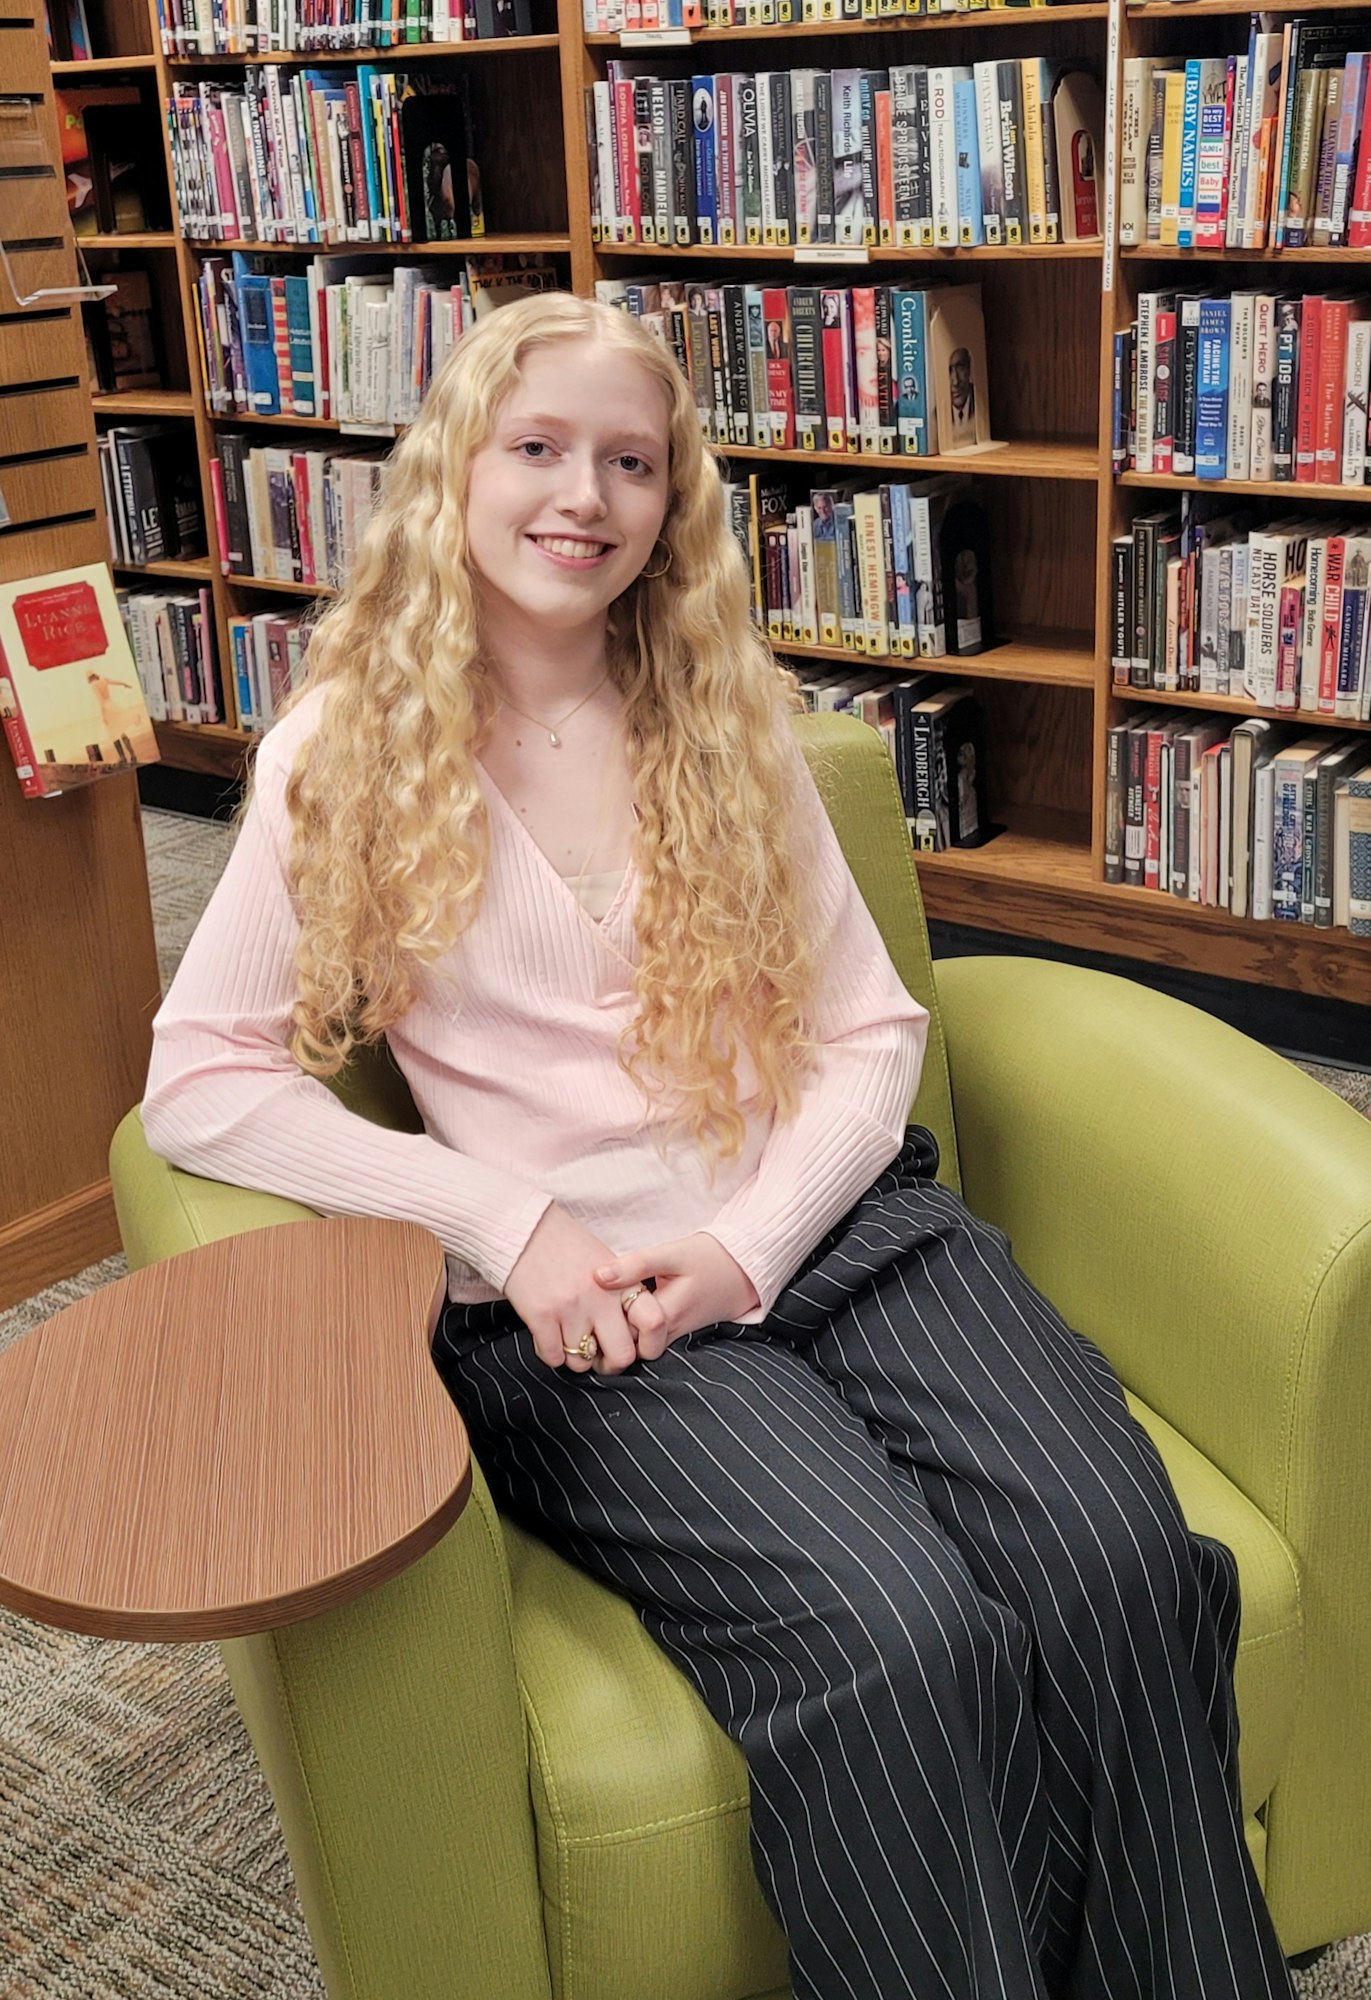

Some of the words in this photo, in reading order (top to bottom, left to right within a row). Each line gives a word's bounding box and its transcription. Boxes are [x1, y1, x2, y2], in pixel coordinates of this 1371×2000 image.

[982, 68, 991, 113] SHANIA
[1239, 66, 1247, 80] The
[248, 93, 257, 117] AWE
[270, 80, 279, 115] Detroit
[619, 86, 627, 125] SOPHIA
[676, 90, 685, 118] HARD
[843, 86, 852, 109] Keith
[894, 77, 907, 116] BRUCE
[934, 88, 945, 119] ROD
[1026, 82, 1034, 100] Am
[1186, 80, 1197, 128] BABY
[1235, 83, 1244, 124] American
[1328, 77, 1337, 105] SAVILL
[652, 87, 664, 134] NELSON
[720, 105, 728, 136] MEACHAM
[743, 88, 756, 137] OLIVIA
[961, 98, 969, 140] DINNERS
[1000, 100, 1012, 146] Brian
[1027, 104, 1037, 141] Malala
[1203, 114, 1222, 122] BEST
[252, 121, 266, 176] INSPIRING
[621, 128, 629, 162] LOREN
[677, 121, 686, 144] CALL
[844, 112, 853, 153] Richards
[861, 126, 872, 161] WILLIAM
[920, 99, 930, 174] ELVIS
[985, 114, 995, 153] TWAIN
[1300, 120, 1311, 170] PATTERSON
[1325, 119, 1337, 169] ALEXANDER
[342, 141, 350, 183] SEABISCUIT
[641, 157, 649, 183] ROB
[843, 161, 853, 178] Life
[896, 121, 910, 200] SPRINGSTEEN
[1003, 145, 1016, 200] Wilson
[1107, 152, 1114, 177] ON
[1181, 130, 1195, 186] NAMES
[1201, 159, 1220, 170] best
[1232, 147, 1240, 174] Thomas
[762, 164, 770, 202] MICHELLE
[820, 148, 828, 207] REYNOLDS
[862, 163, 873, 198] SHATNER
[1148, 167, 1160, 214] WOMEN
[1200, 177, 1219, 187] Baby
[1324, 172, 1332, 186] THE
[1321, 188, 1332, 214] GREAT
[1104, 194, 1114, 290] SHELVES
[792, 307, 816, 315] ROBERTS
[793, 297, 814, 306] ANDREW
[1140, 299, 1150, 337] STEPHEN
[692, 321, 703, 355] LAURA
[710, 314, 718, 335] LAST
[734, 301, 744, 351] ANDREW
[901, 297, 917, 372] Cronkite
[1259, 304, 1269, 338] QUIET
[1305, 322, 1314, 349] GUEST
[711, 337, 720, 368] WORDS
[1212, 340, 1221, 365] FACING
[1258, 342, 1268, 374] HERO
[1279, 334, 1292, 354] PT
[1353, 333, 1364, 387] UNBROKEN
[696, 359, 706, 388] BUSH
[796, 325, 816, 401] CHURCHILL
[1140, 349, 1149, 391] AMBROSE
[1183, 330, 1195, 403] FLYBOYS
[1202, 341, 1211, 384] MOUNTAIN
[1212, 366, 1220, 385] THE
[1278, 359, 1292, 384] 109
[737, 357, 748, 410] CARNEGI
[879, 371, 888, 412] KATIE
[1326, 382, 1334, 401] The
[1140, 394, 1148, 409] THE
[1139, 413, 1148, 434] WILD
[1302, 420, 1310, 446] PETER
[1323, 403, 1333, 444] Mathews
[120, 466, 136, 517] LETTERMAN
[761, 495, 787, 515] FOX
[864, 515, 875, 559] ERNEST
[883, 519, 891, 537] Ernest
[1220, 562, 1229, 590] WAR
[1235, 558, 1245, 596] BUSTER
[1262, 552, 1277, 599] HORSE
[1307, 548, 1322, 605] Homecoming
[1327, 553, 1342, 581] WAR
[868, 564, 880, 636] HEMINGWY
[1206, 570, 1214, 606] AMERICAN
[1324, 585, 1340, 622] CHILD
[24, 603, 92, 628] LUANNE
[1218, 594, 1229, 625] DOGS
[1307, 610, 1316, 623] Bob
[1343, 605, 1352, 644] CANDICE
[42, 621, 86, 640] RICE
[1261, 603, 1274, 655] SOLDIERS
[1307, 624, 1315, 647] Greene
[1285, 647, 1295, 664] TEAM
[1323, 650, 1332, 685] EMMANUEL
[1340, 647, 1350, 686] MILLARD
[914, 726, 930, 807] LINDBERGH
[1134, 785, 1142, 821] KENNEDY'S
[1282, 793, 1290, 827] FREEDOM
[1289, 783, 1297, 810] BATTLE
[1305, 785, 1313, 806] CIVIL
[1305, 838, 1313, 868] GHOSTS
